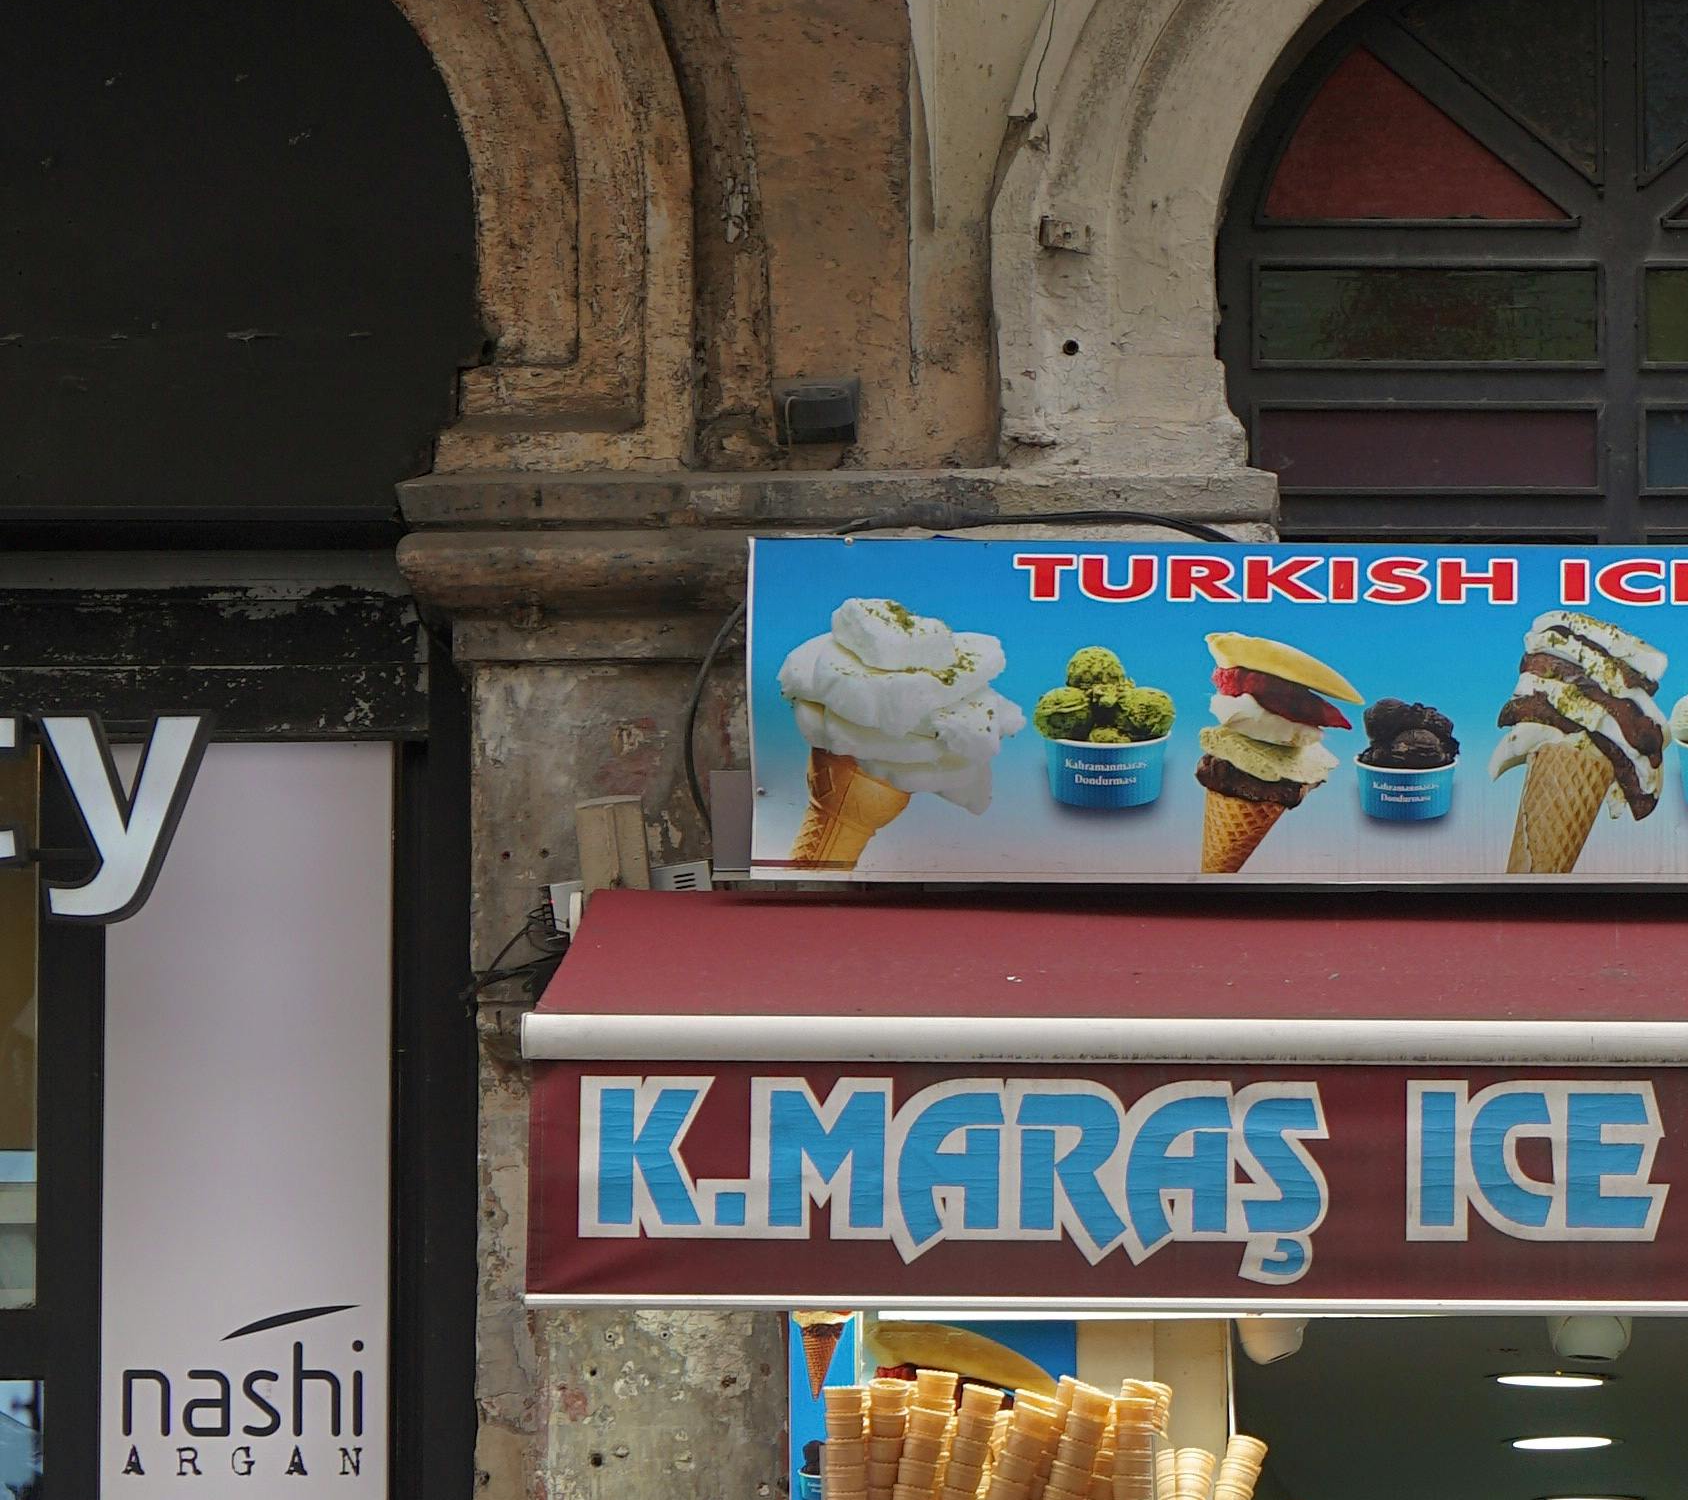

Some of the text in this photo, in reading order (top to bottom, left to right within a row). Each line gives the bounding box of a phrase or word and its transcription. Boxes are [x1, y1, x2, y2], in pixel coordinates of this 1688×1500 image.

[1013, 553, 1520, 605] TURKISH
[0, 717, 200, 916] y
[578, 1076, 1328, 1285] K.MARAŞ
[1406, 1080, 1670, 1243] ICE
[122, 1340, 364, 1437] nashi
[121, 1444, 363, 1476] ARGAN
